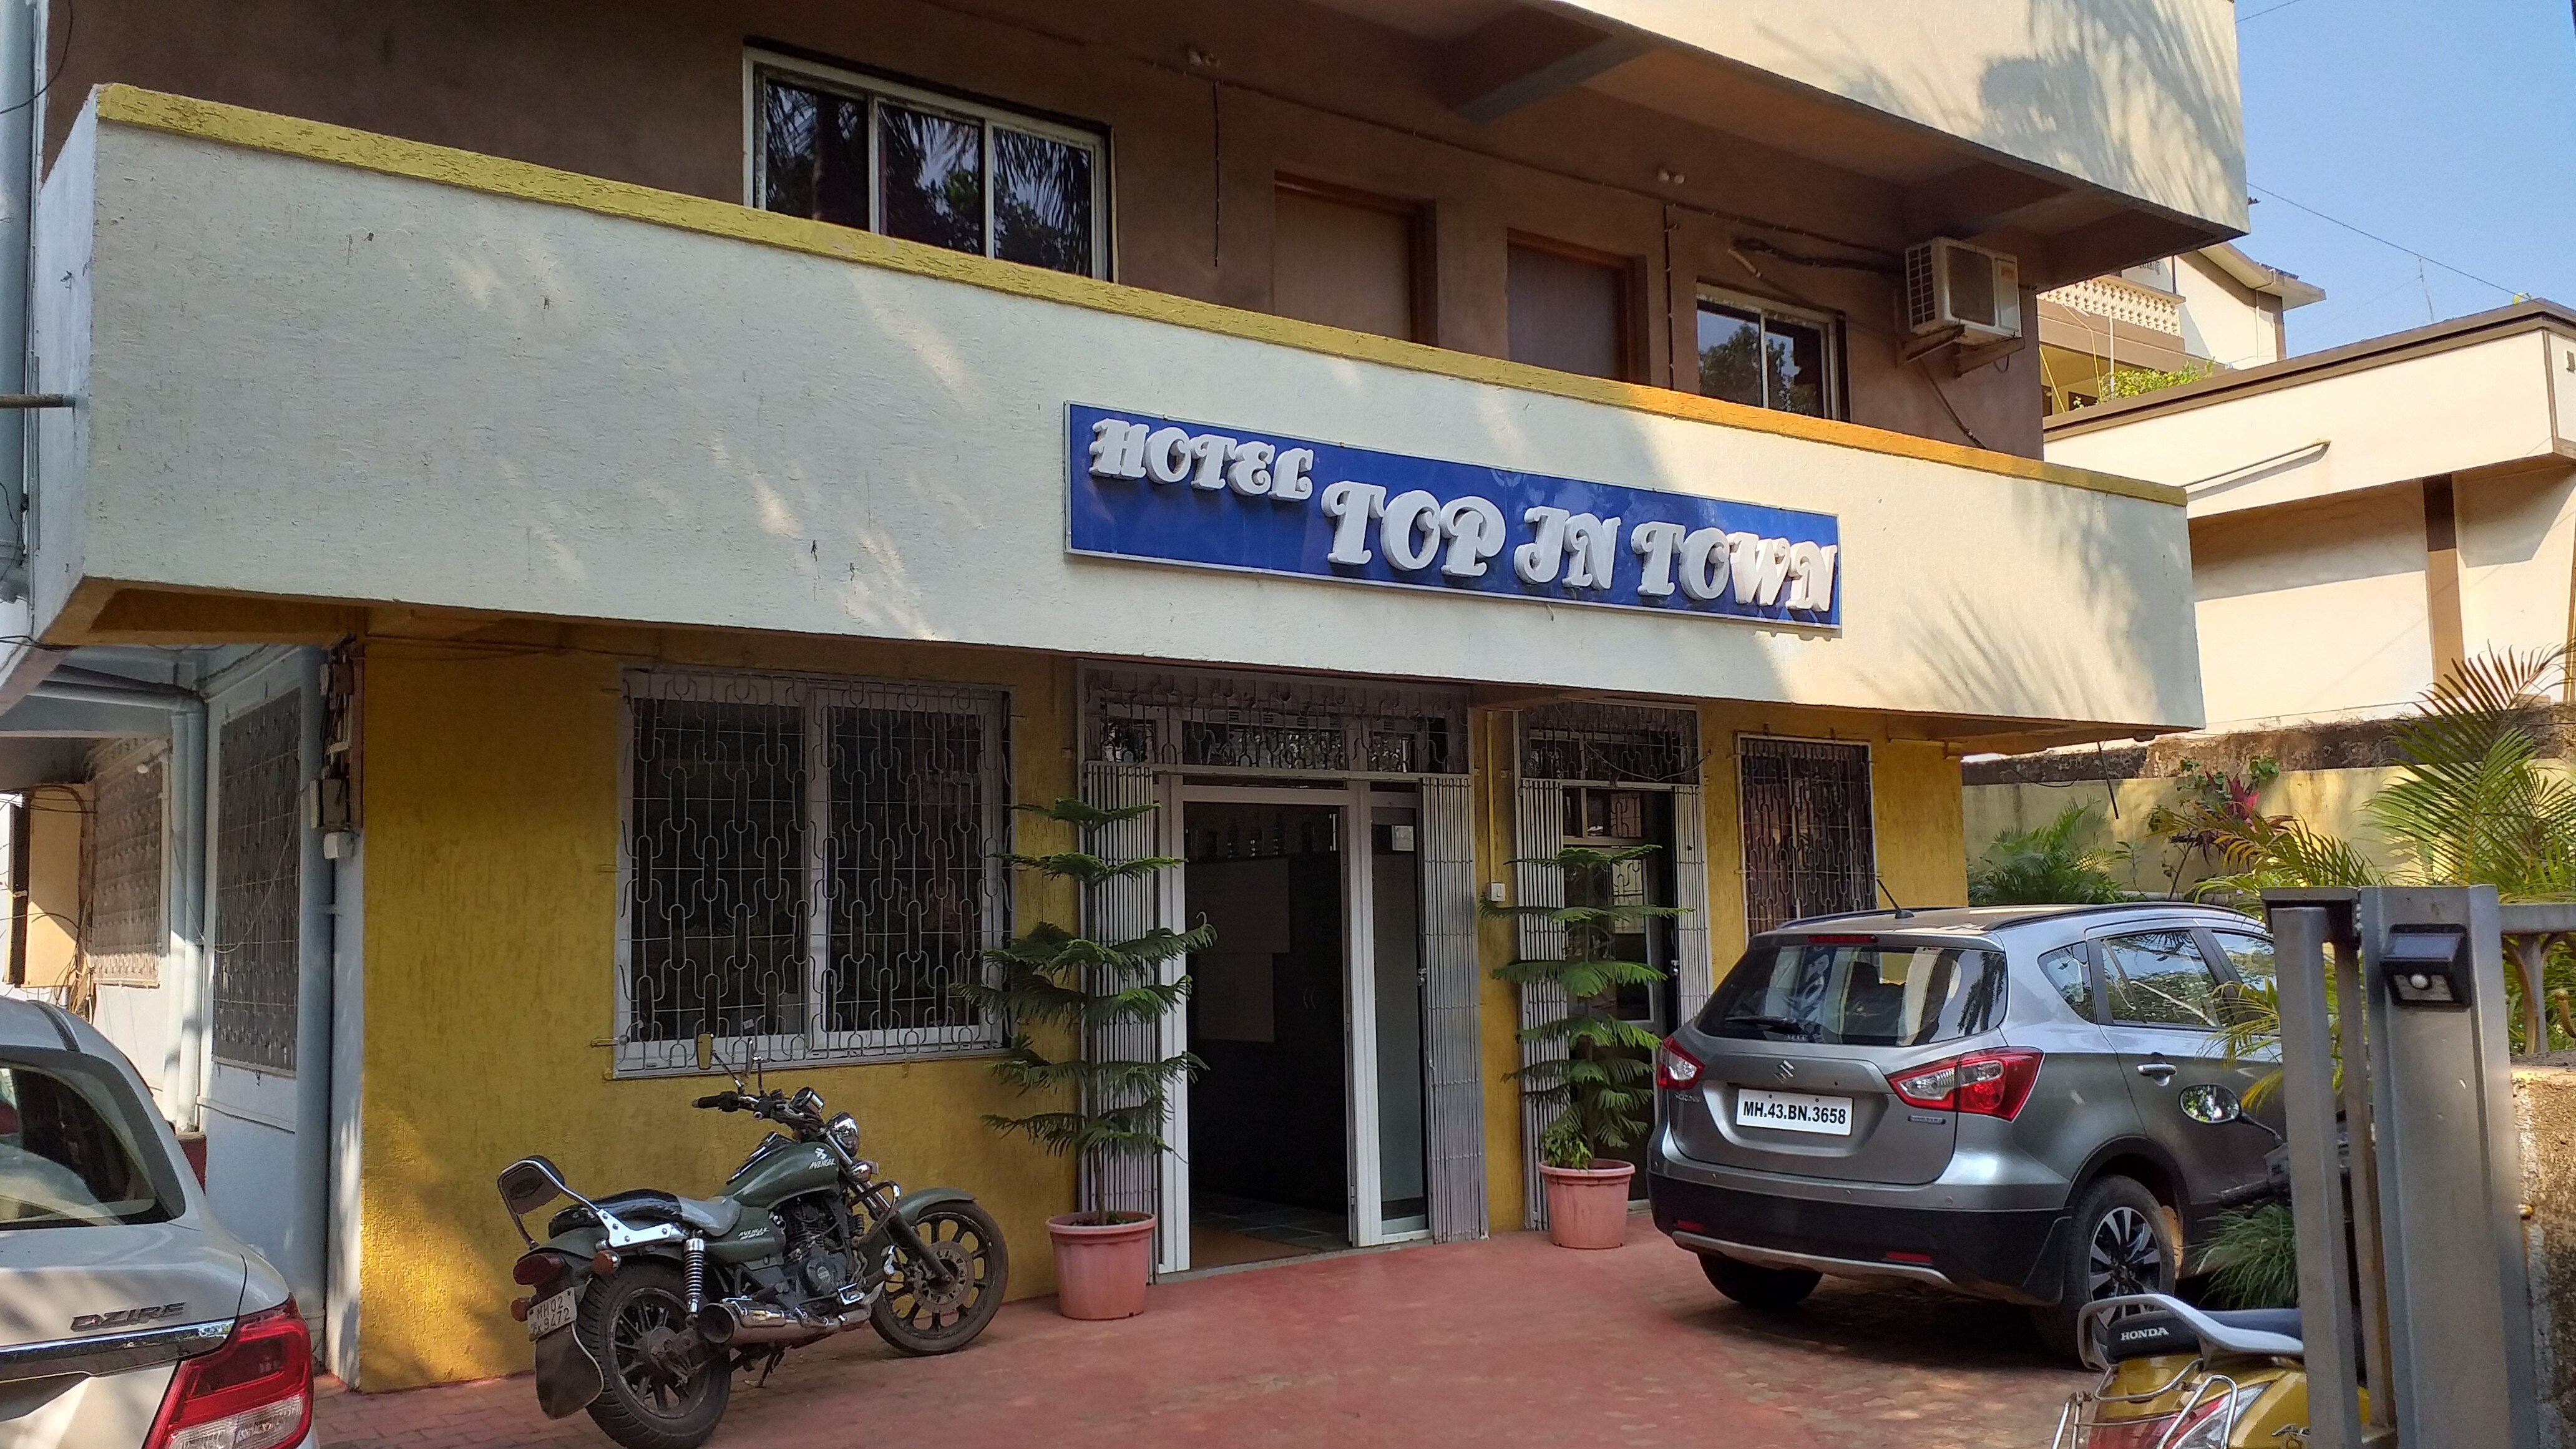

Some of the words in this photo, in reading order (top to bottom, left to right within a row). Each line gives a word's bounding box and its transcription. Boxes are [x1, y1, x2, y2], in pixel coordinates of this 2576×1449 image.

[1088, 417, 1314, 502] HOTEL
[1321, 480, 1506, 578] TOP
[1514, 505, 1622, 590] IN
[1630, 520, 1838, 613] TOWN
[809, 1158, 836, 1170] AVENGER
[71, 1302, 186, 1331] DZIRE
[2120, 1327, 2169, 1341] HONDA
